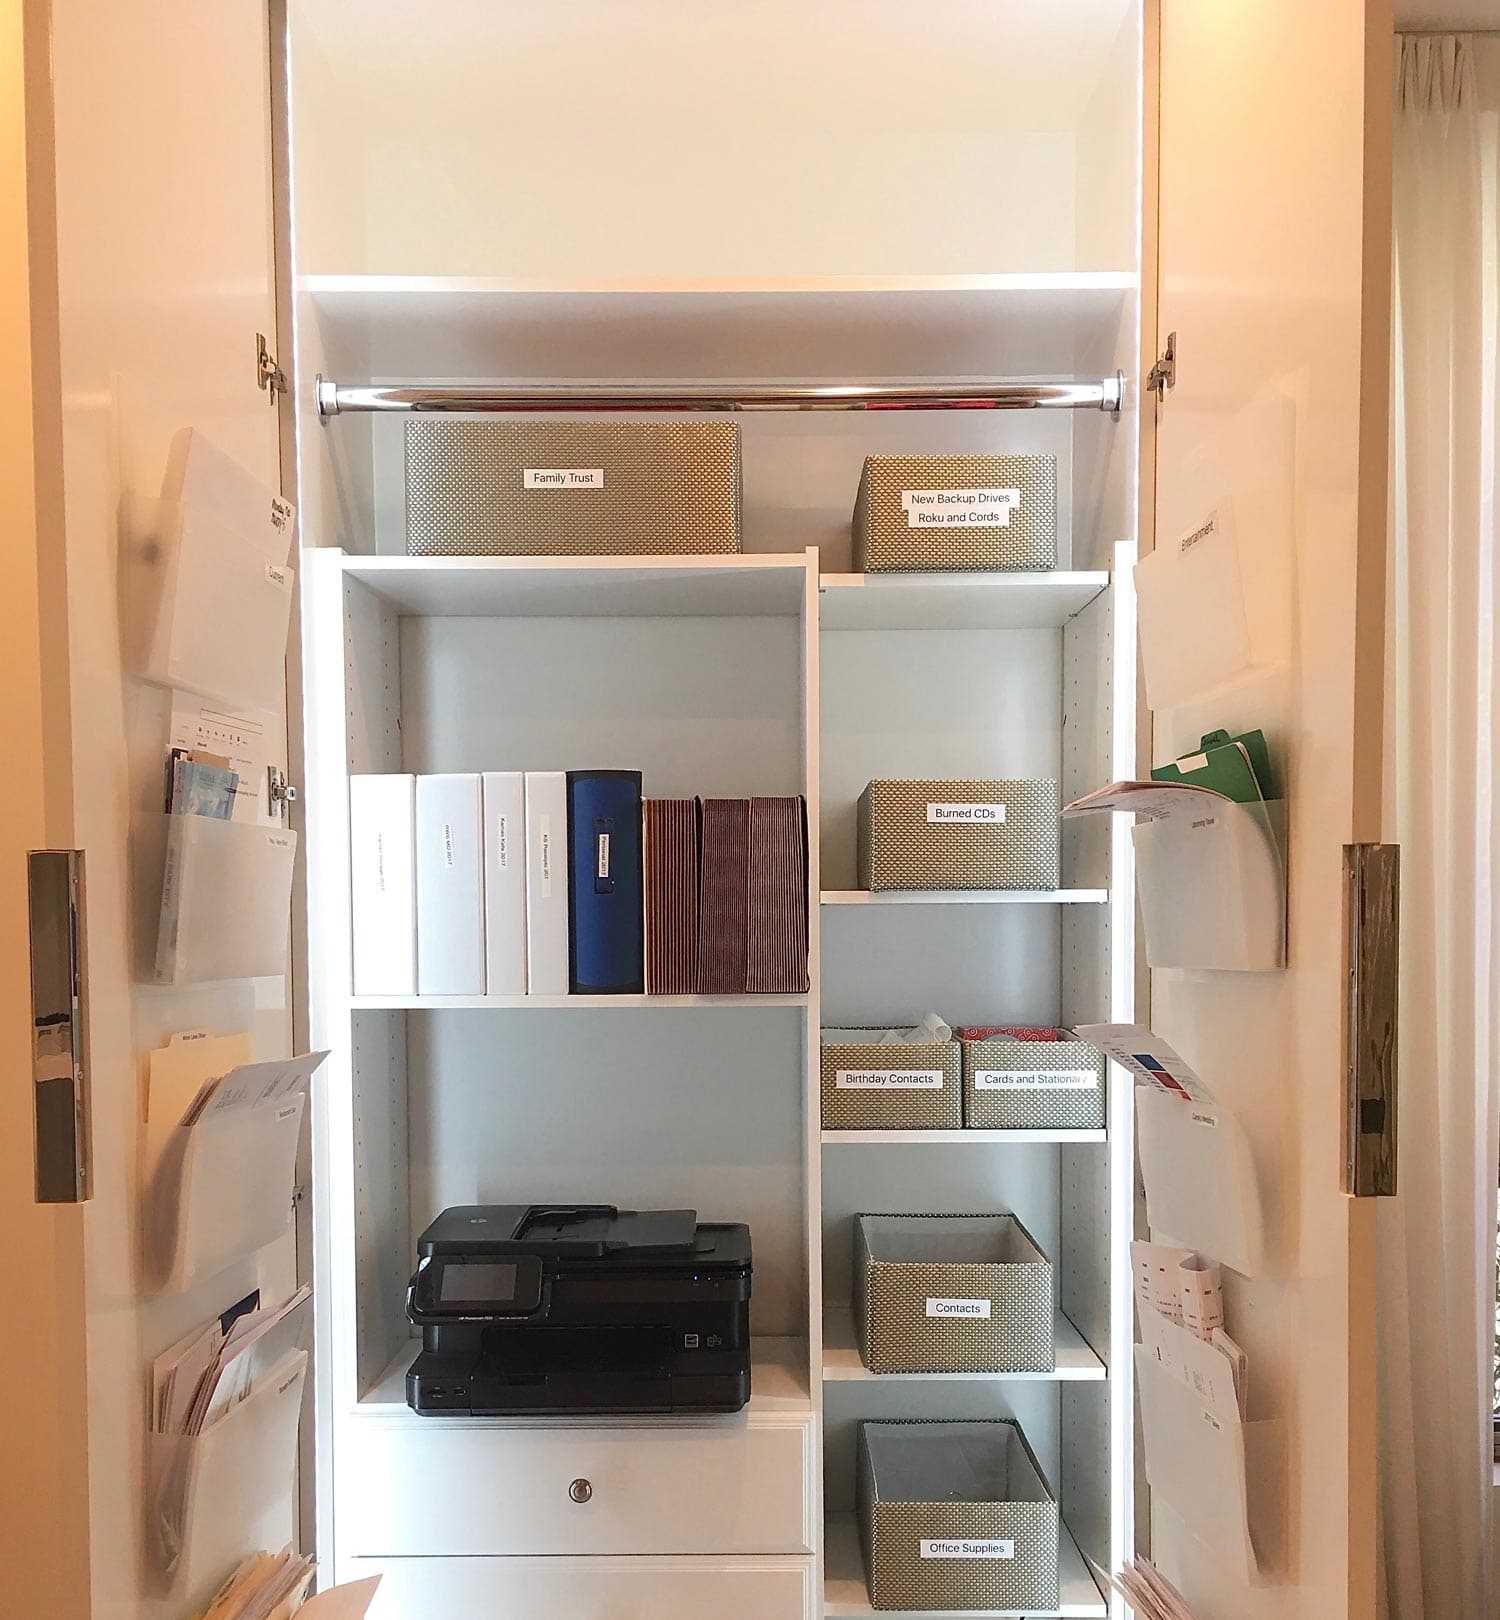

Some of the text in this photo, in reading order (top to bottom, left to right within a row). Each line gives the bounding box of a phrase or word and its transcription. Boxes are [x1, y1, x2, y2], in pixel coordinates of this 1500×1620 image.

[533, 473, 594, 485] Family Trust
[911, 493, 1010, 505] New Backup Drives
[918, 512, 1000, 523] Roku and Cords
[1181, 520, 1214, 552] Entertainment
[935, 808, 996, 818] Burned CDs
[846, 1074, 934, 1085] Birthday Contacts
[984, 1074, 1087, 1086] Cards and Stationary
[935, 1303, 981, 1314] Contacts
[929, 1543, 1005, 1555] Office Supplies
